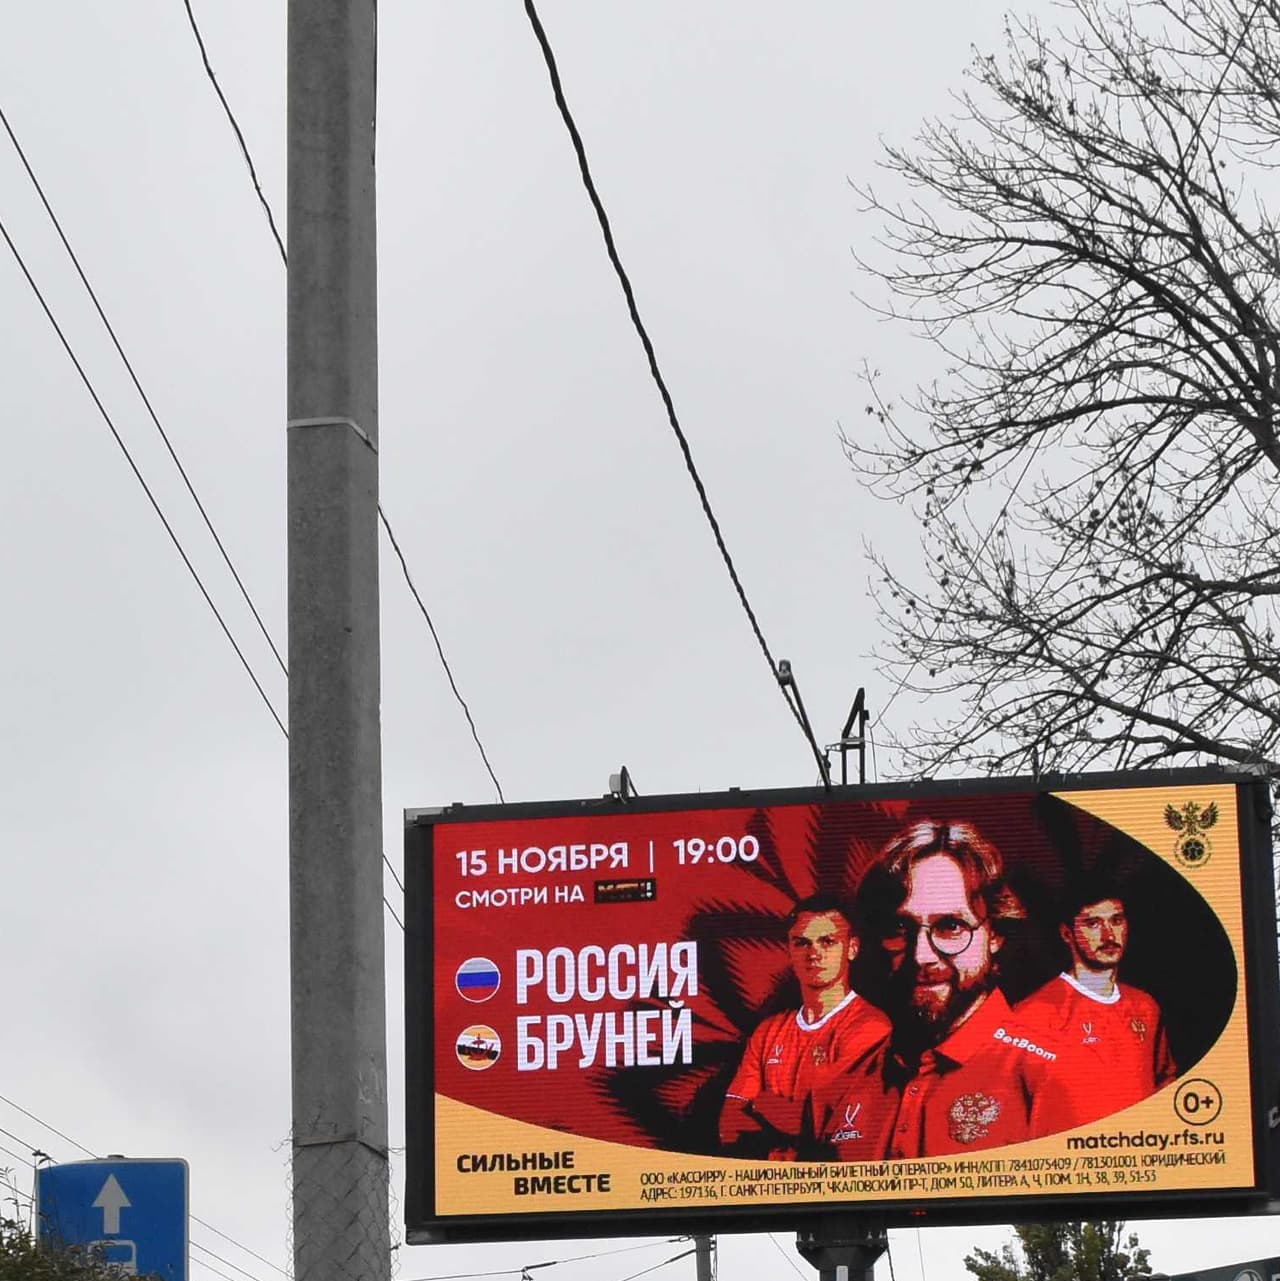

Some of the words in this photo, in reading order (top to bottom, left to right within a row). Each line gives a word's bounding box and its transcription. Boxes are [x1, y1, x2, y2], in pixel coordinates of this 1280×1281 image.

[456, 849, 487, 876] 15
[497, 842, 629, 874] НОЯБРЯ
[673, 835, 759, 865] 19:00
[455, 886, 548, 908] СМОТРИ
[554, 885, 585, 904] НА
[516, 941, 698, 1004] РОССИЯ
[516, 999, 693, 1071] БРУНЕЙ
[992, 1028, 1057, 1062] BetBoom
[1182, 1091, 1214, 1114] 0+
[1067, 1129, 1225, 1150] matchday.rfs.ru
[456, 1151, 575, 1173] СИЛЬНЫЕ
[640, 1172, 664, 1185] ООО
[735, 1164, 829, 1182] НАЦИОНАЛЬНЫЙ
[830, 1162, 890, 1178] БИЛЕТНЫЙ
[1141, 1150, 1226, 1167] ЮРИДИЧЕСКИЙ
[513, 1173, 611, 1196] ВМЕСТЕ
[827, 1176, 901, 1193] ЧКАЛОВСКИЙ
[930, 1177, 957, 1192] ДОМ
[977, 1174, 1018, 1188] ЛИТЕРА
